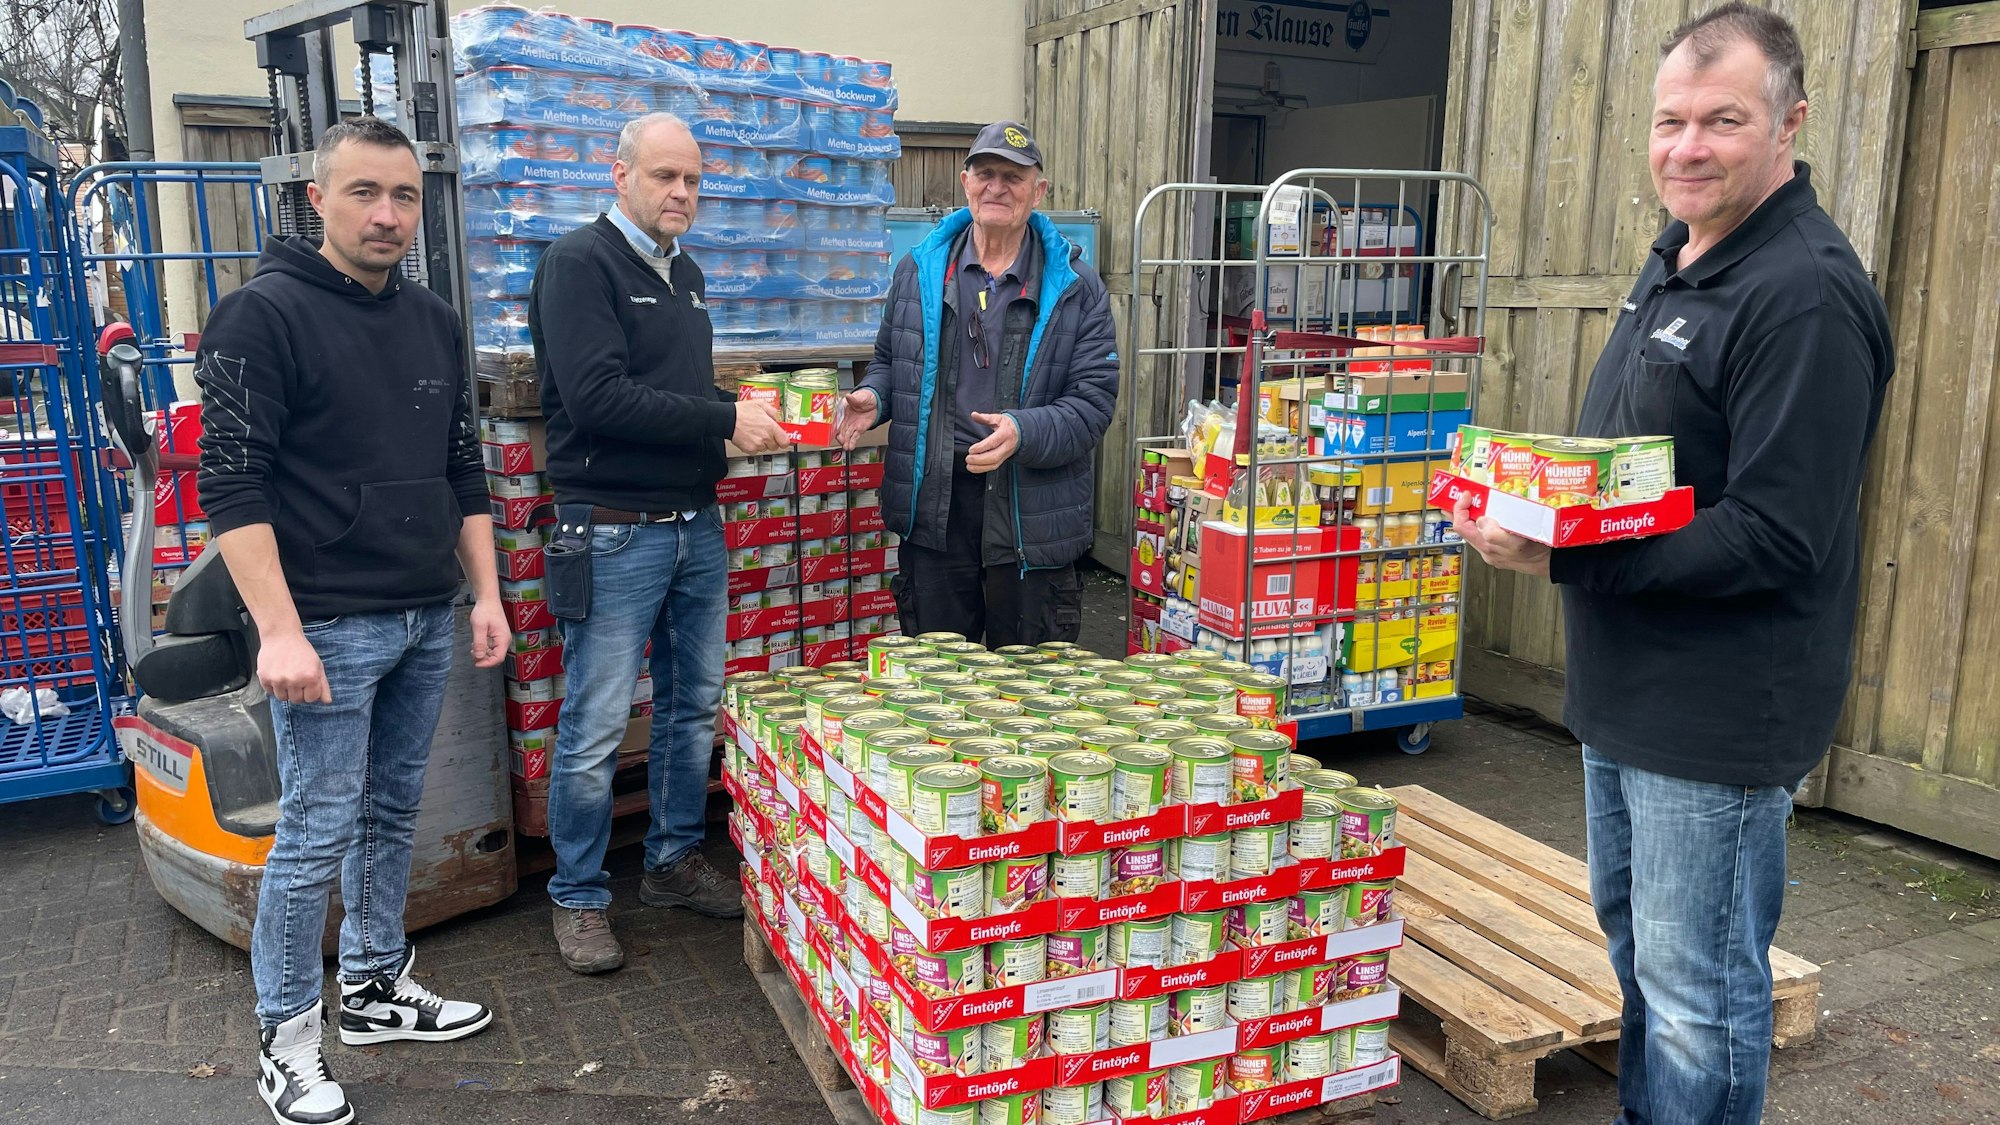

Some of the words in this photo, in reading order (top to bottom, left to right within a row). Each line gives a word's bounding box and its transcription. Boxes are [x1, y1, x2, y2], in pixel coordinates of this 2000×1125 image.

[1245, 4, 1334, 47] Klause
[521, 45, 558, 61] Metten
[560, 51, 612, 67] Bockwurst
[835, 86, 877, 103] Bockwurst
[543, 109, 579, 125] Metten
[581, 114, 626, 130] Bockwur
[705, 124, 737, 139] Metten
[827, 137, 856, 152] Metten
[523, 164, 560, 180] Metten
[562, 169, 613, 182] Bockwurst
[702, 180, 747, 193] Bockwurst
[806, 186, 836, 201] Metten
[820, 236, 847, 248] Metten
[848, 238, 884, 248] Bockwurst
[834, 284, 872, 296] Bockwurst
[816, 330, 843, 341] Metten
[1545, 463, 1592, 477] HÜHNER
[1547, 476, 1587, 486] NUDELTOPF
[1600, 512, 1656, 534] Eintöpfe
[1260, 546, 1276, 554] Tuben
[1285, 546, 1291, 554] je
[1430, 579, 1450, 588] Ravioli
[1428, 617, 1447, 625] Ravioli
[1240, 696, 1272, 706] HÜHNER
[137, 737, 184, 781] STILL
[1226, 808, 1271, 826] Eintöpfe
[1103, 825, 1151, 844] Eintöpfe
[969, 841, 1020, 860] Eintöpfe
[1125, 853, 1158, 865] LINSEN
[1009, 867, 1020, 878] GUT
[1130, 863, 1154, 871] EINTOPF
[1331, 863, 1374, 880] Eintöpfe
[1222, 884, 1267, 903] Eintöpfe
[1099, 901, 1147, 921] Eintöpfe
[970, 920, 1022, 941] Eintöpfe
[1274, 944, 1318, 963] Eintöpfe
[1355, 963, 1385, 975] LINSEN
[1161, 969, 1207, 988] Eintöpfe
[962, 996, 1014, 1017] Eintöpfe
[1269, 1015, 1314, 1034] Eintöpfe
[1091, 1051, 1141, 1071] Eintöpfe
[1232, 1057, 1268, 1069] HÜHNER
[967, 1077, 1019, 1099] Eintöpfe
[1269, 1087, 1314, 1107] Eintöpfe
